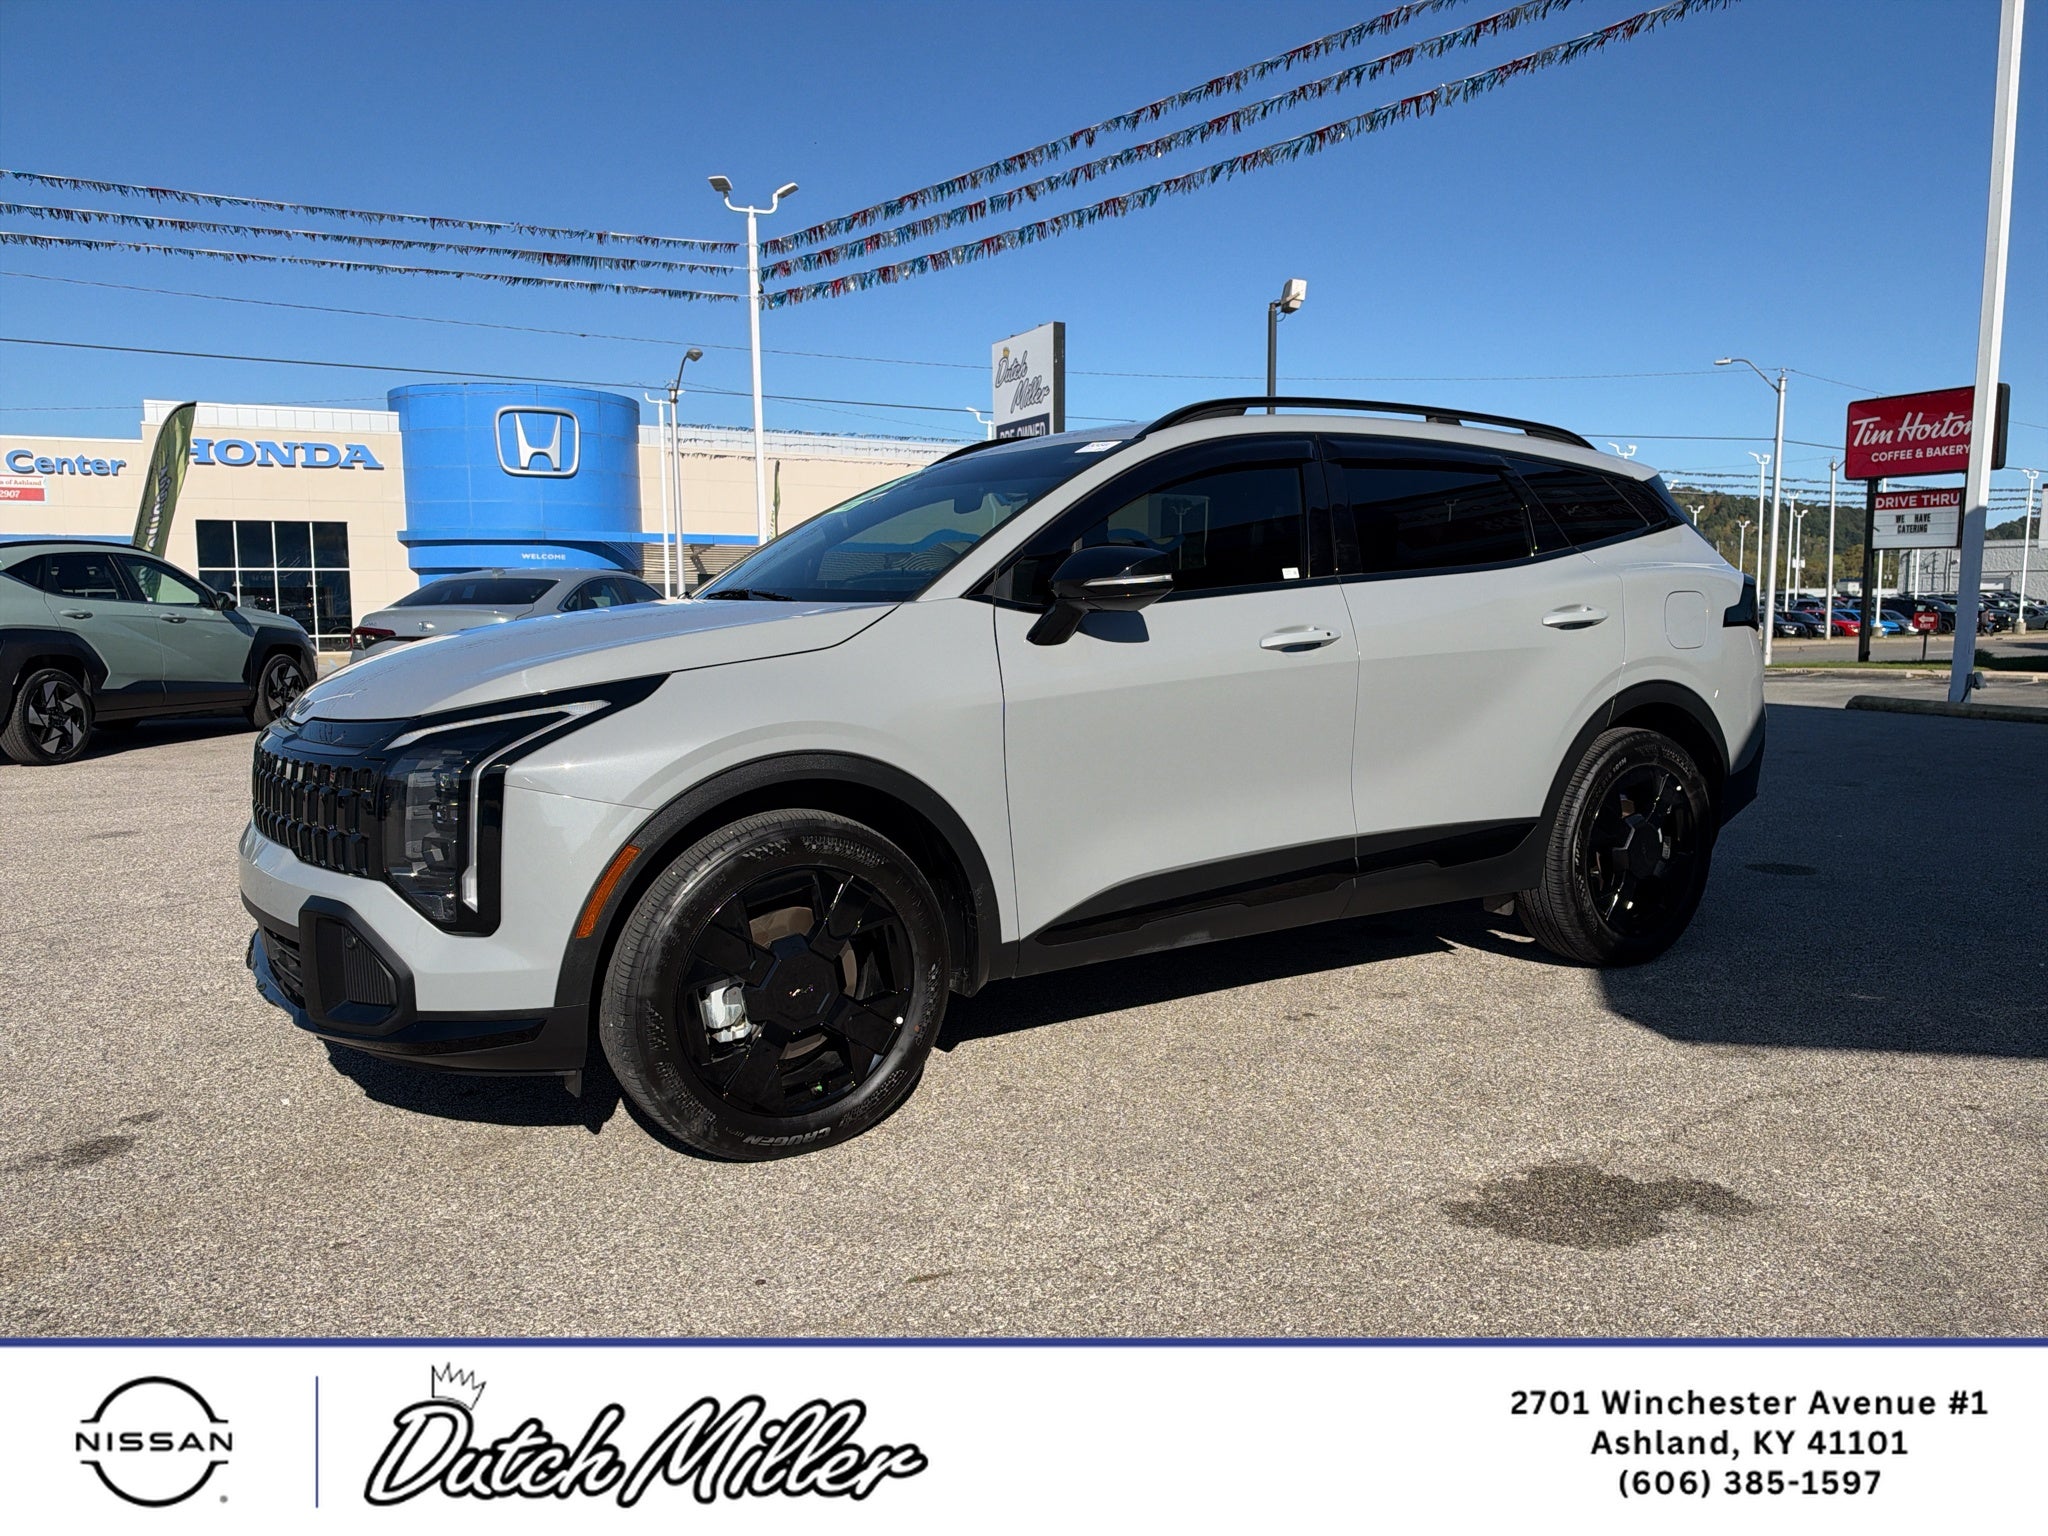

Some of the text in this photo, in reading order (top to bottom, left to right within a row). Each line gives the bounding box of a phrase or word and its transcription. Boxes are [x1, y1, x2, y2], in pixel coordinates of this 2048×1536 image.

[995, 350, 1028, 388] Dutch
[1010, 375, 1050, 414] Miller
[1852, 411, 1972, 447] Tim Horto
[5, 449, 127, 476] Center
[190, 438, 384, 470] HONDA
[1871, 443, 1971, 463] COFFEE & BAKERY
[1875, 492, 1960, 509] DRIVE THRU
[1896, 513, 1931, 524] WE HAVE
[1897, 524, 1928, 535] CATERING
[521, 552, 567, 560] WELCOME
[742, 1126, 832, 1147] CRUGEN
